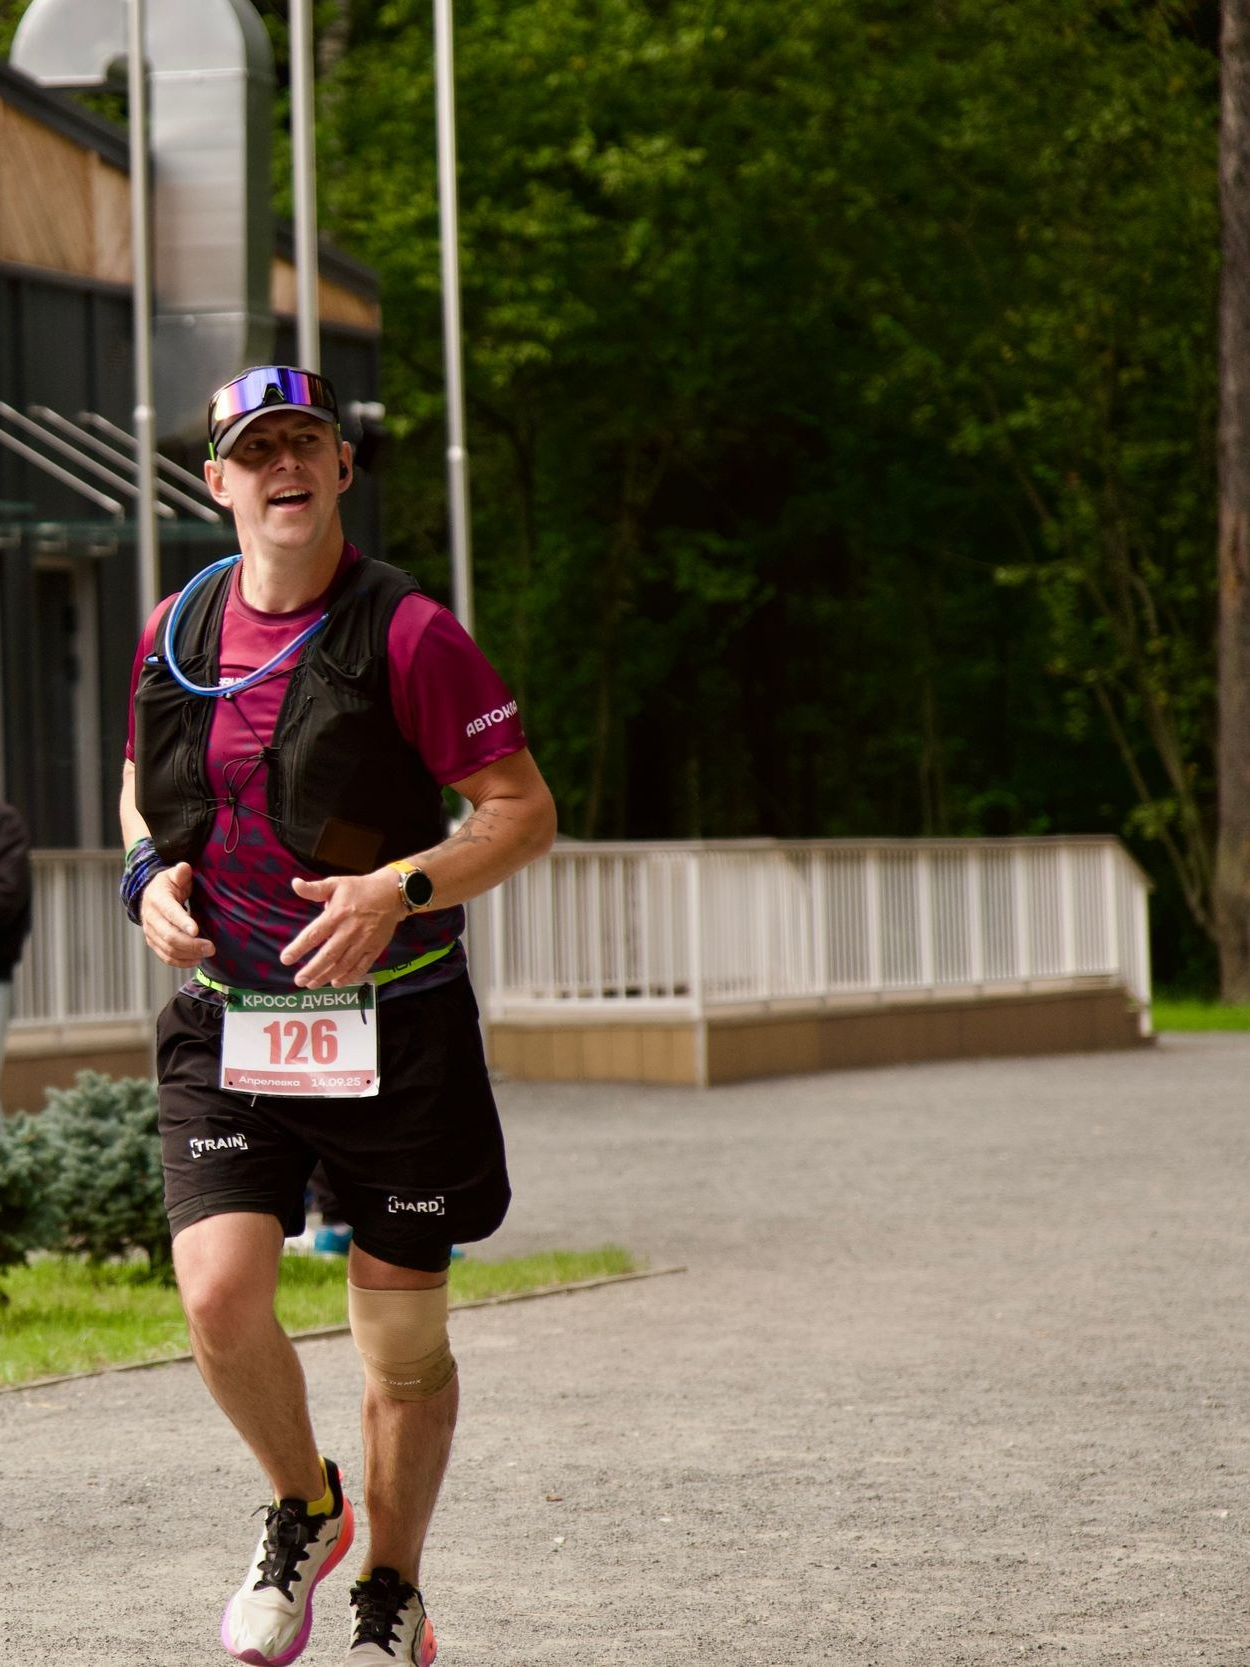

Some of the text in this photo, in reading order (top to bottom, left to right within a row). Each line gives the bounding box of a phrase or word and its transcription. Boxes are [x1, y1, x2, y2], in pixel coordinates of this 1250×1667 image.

[242, 992, 359, 1009] КРОСС ДУБКИ
[263, 1018, 338, 1065] 126
[238, 1075, 361, 1088] Апрелевка 14.09.25
[194, 1135, 244, 1153] TRAIN
[394, 1200, 439, 1213] HARD
